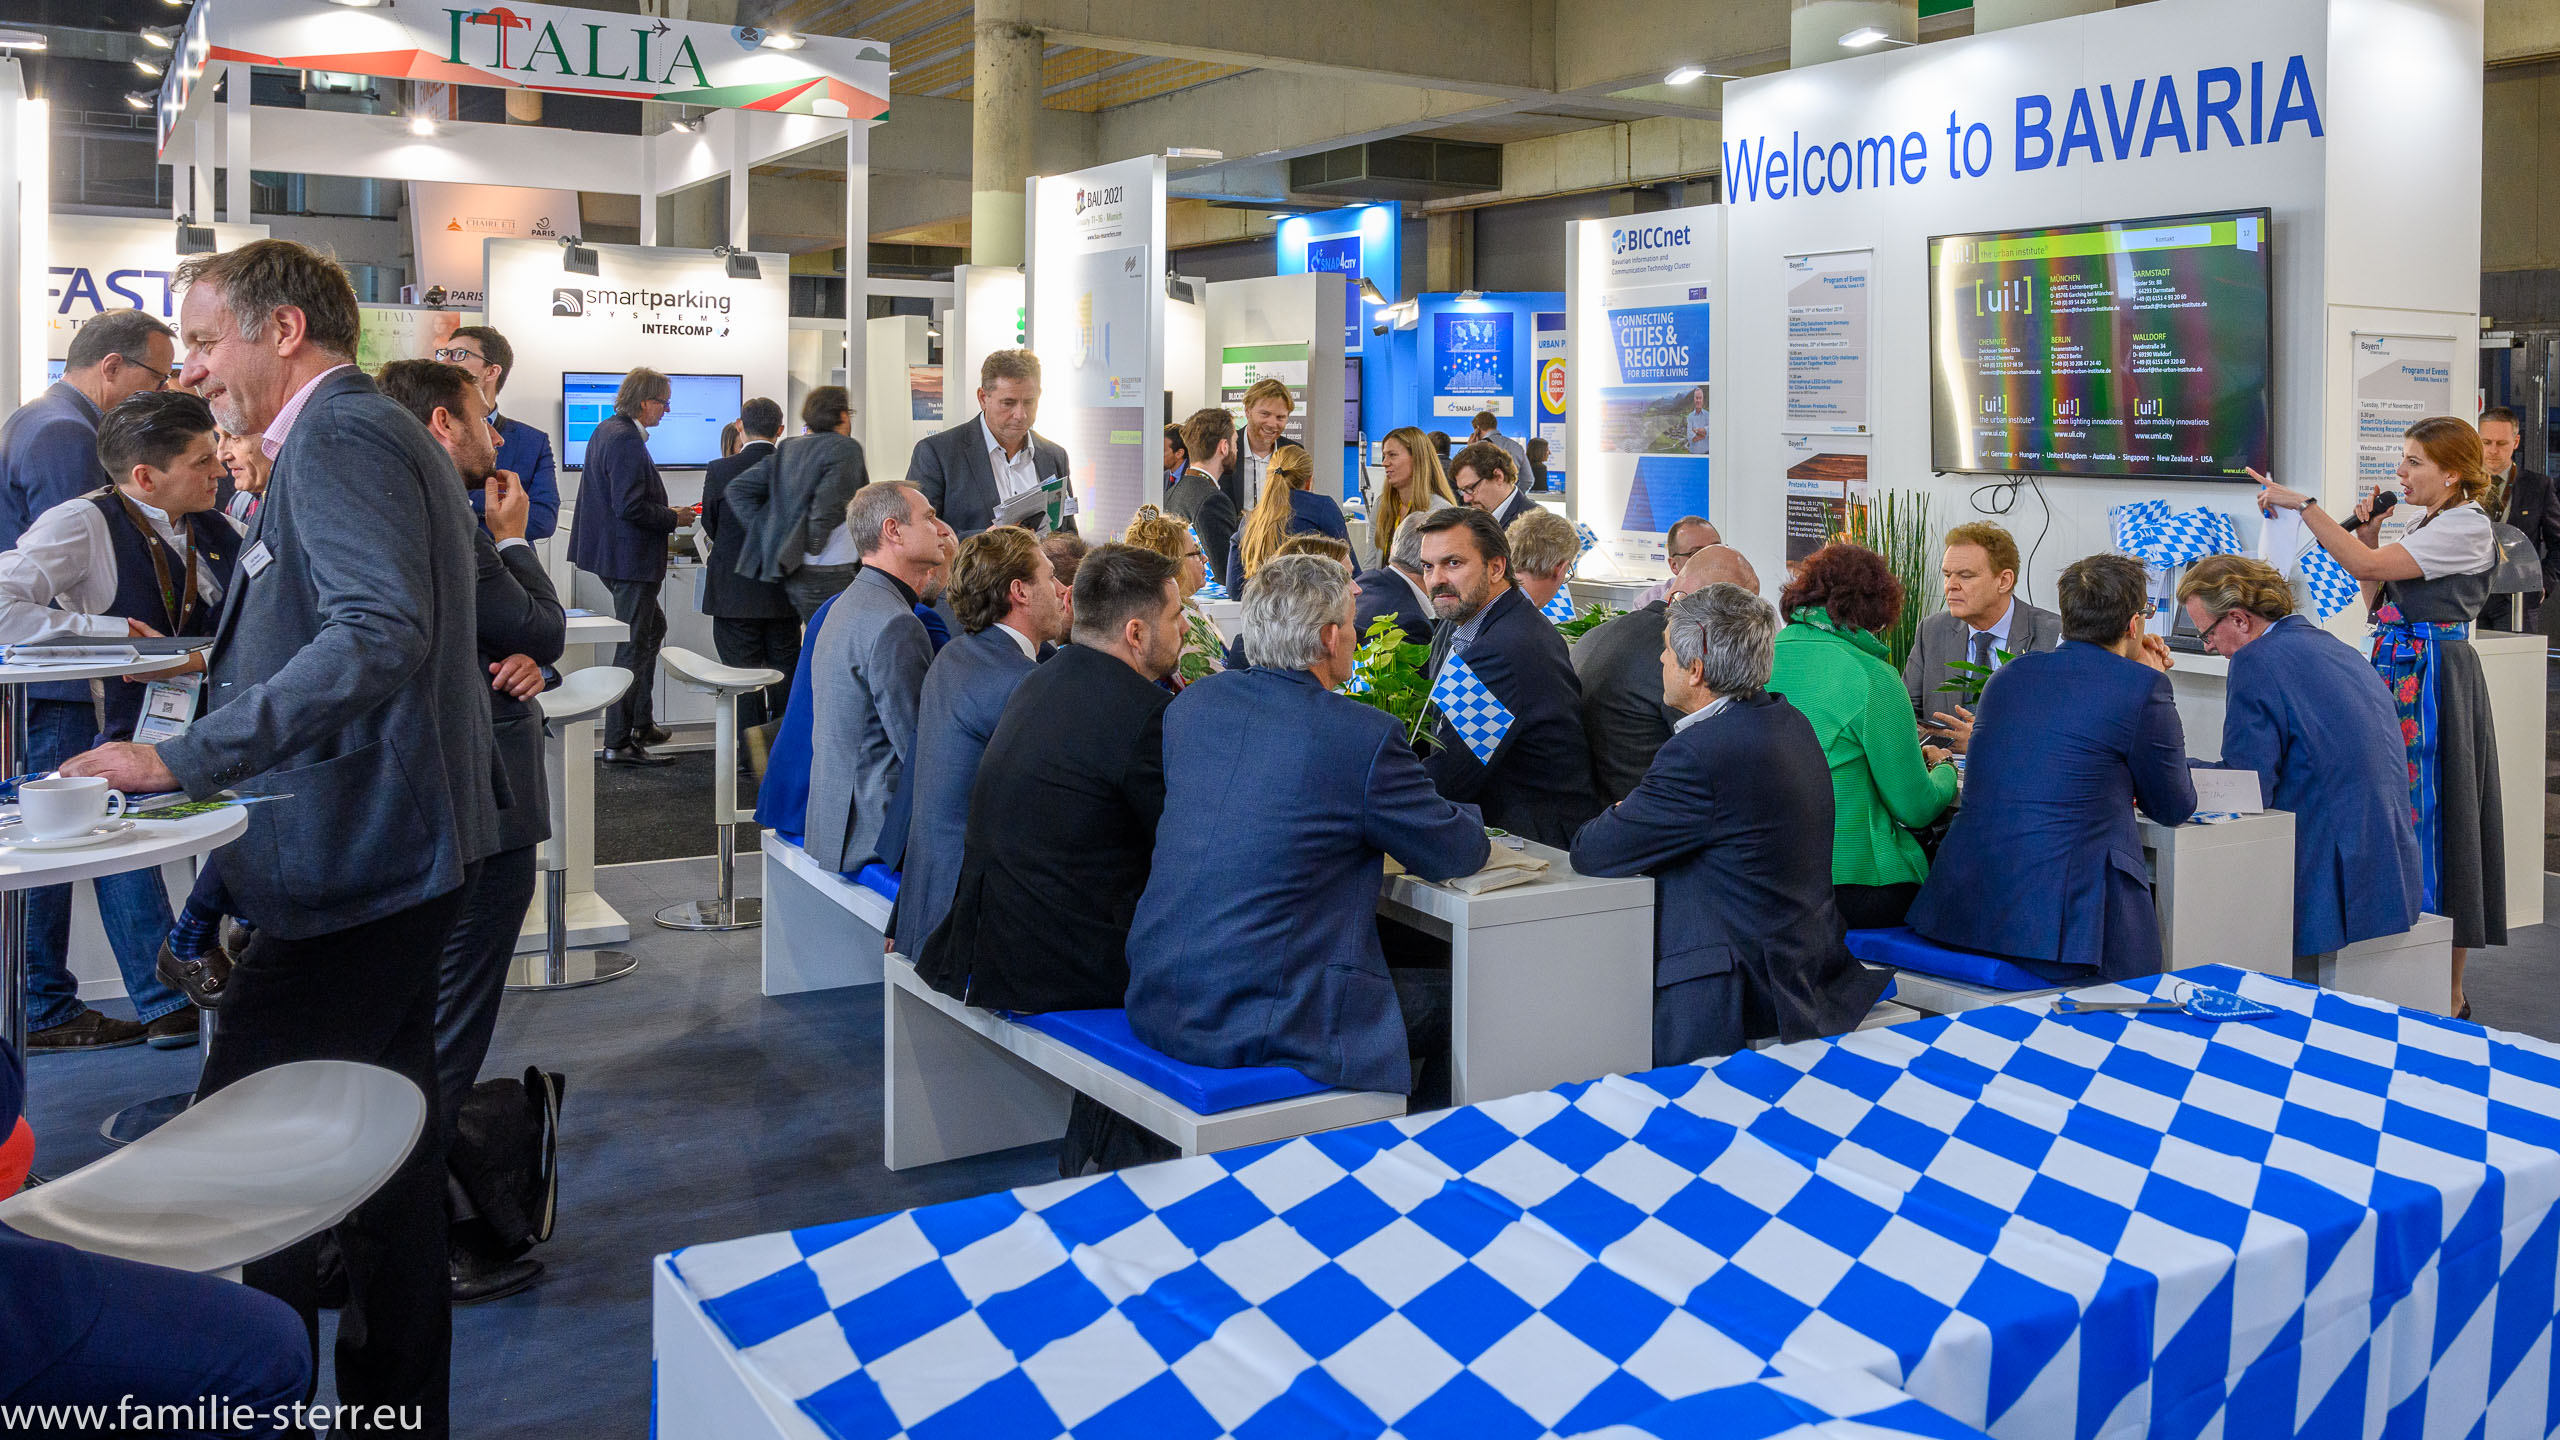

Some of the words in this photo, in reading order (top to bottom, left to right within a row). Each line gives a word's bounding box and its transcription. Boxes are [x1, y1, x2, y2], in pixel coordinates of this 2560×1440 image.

[441, 8, 713, 88] ITALIA
[1722, 131, 1928, 205] Welcome
[1947, 110, 1992, 179] to
[2015, 55, 2324, 172] BAVARIA
[1087, 190, 1103, 208] BAU
[1104, 185, 1123, 205] 2021
[531, 229, 556, 237] PARIS
[1628, 225, 1691, 251] BICCnet
[1993, 248, 2015, 258] urban
[1611, 258, 1631, 266] Bavarian
[1631, 255, 1659, 264] Information
[1611, 267, 1647, 275] Communication
[1647, 263, 1673, 272] Technology
[2132, 268, 2171, 277] DARMSTADT
[2050, 273, 2081, 283] MÜNCHEN
[586, 289, 731, 314] smartparking
[1616, 312, 1674, 327] CONNECTING
[642, 323, 713, 336] INTERCOMP
[1620, 325, 1663, 347] CITIES
[1665, 325, 1678, 345] &
[1978, 337, 2007, 346] CHEMNITZ
[2051, 336, 2071, 344] BERLIN
[2132, 333, 2167, 341] WALLDORF
[1538, 339, 1560, 349] URBAN
[2361, 341, 2380, 351] Bayern
[1624, 346, 1690, 368] REGIONS
[1627, 369, 1640, 378] FOR
[1641, 368, 1665, 378] BETTER
[1665, 367, 1689, 377] LIVING
[2401, 365, 2425, 375] Program
[2425, 367, 2431, 375] of
[2431, 367, 2449, 376] Events
[1979, 394, 2008, 414] [ui!]
[2052, 398, 2080, 416] [ui!]
[2134, 398, 2163, 416] [ui!]
[2361, 401, 2379, 409] Tuesday,
[1990, 416, 2007, 424] urban
[2052, 417, 2070, 425] urban
[2069, 417, 2091, 427] lighting
[2091, 417, 2124, 425] innovations
[2134, 417, 2151, 425] urban
[2151, 417, 2175, 427] mobility
[2175, 418, 2210, 426] innovations
[2134, 432, 2173, 440] www.umi.city
[1990, 451, 2013, 459] Germany
[2018, 451, 2041, 460] Hungary
[2046, 451, 2064, 459] United
[2064, 452, 2088, 461] Kingdom
[2122, 453, 2150, 462] Singapore
[2156, 454, 2170, 462] New
[2170, 455, 2193, 463] Zealand
[2200, 455, 2213, 463] USA
[1788, 481, 1807, 489] Pretzels
